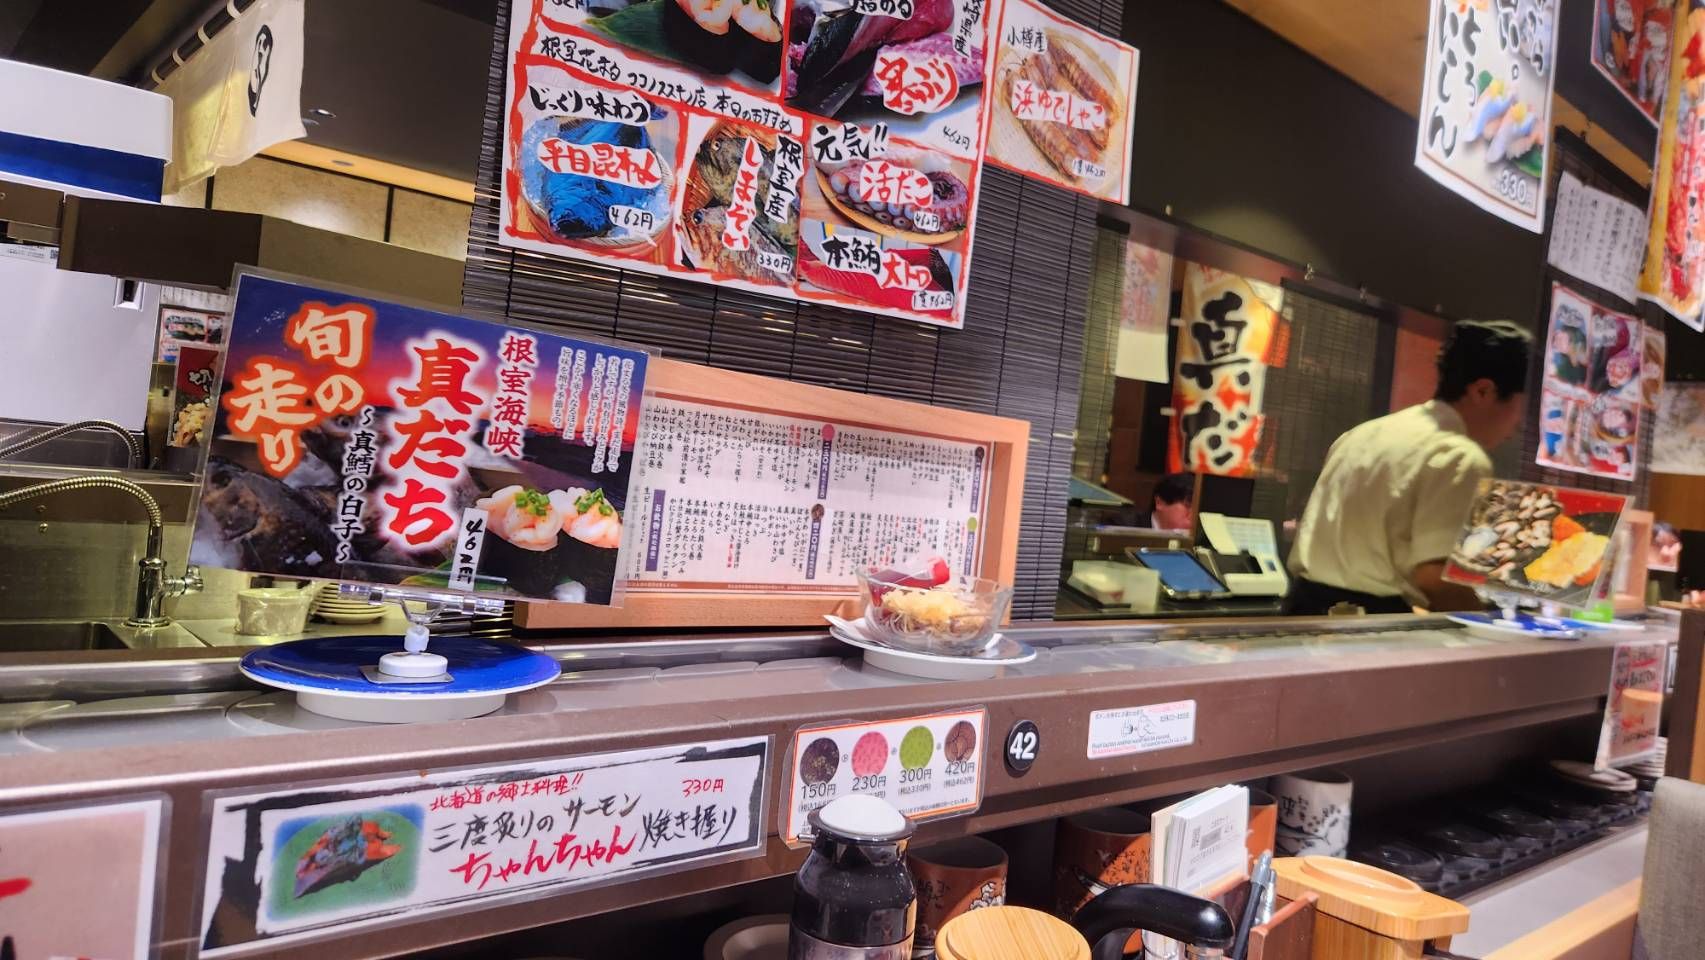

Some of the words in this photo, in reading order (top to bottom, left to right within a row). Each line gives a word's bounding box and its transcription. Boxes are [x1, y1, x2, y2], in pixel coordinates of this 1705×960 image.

[1007, 26, 1045, 52] 小樽産
[540, 36, 621, 81] 根室花まる
[713, 88, 793, 134] 本日のおすすめ
[528, 84, 649, 124] じっくり味わう
[1012, 83, 1107, 130] 浜ゆでしゃこ
[943, 125, 971, 151] 462円
[769, 136, 800, 219] 根室産
[863, 161, 935, 207] 活だこ
[611, 206, 653, 231] 462円
[915, 212, 938, 229] 462円
[758, 254, 792, 272] 330円
[293, 309, 368, 412] 旬の
[487, 334, 536, 458] 根室海峡
[229, 363, 318, 473] 走り
[383, 338, 483, 547] 真だち
[1009, 730, 1037, 761] 42
[852, 774, 887, 791] 230円
[900, 767, 932, 784] 300円
[945, 760, 975, 775] 420円
[681, 778, 725, 798] 330円
[801, 782, 837, 800] 150円
[429, 811, 555, 853] 三度炙りの
[564, 792, 643, 827] サーモン
[449, 824, 638, 891] ちゃんちゃん
[638, 804, 738, 852] 焼き握り
